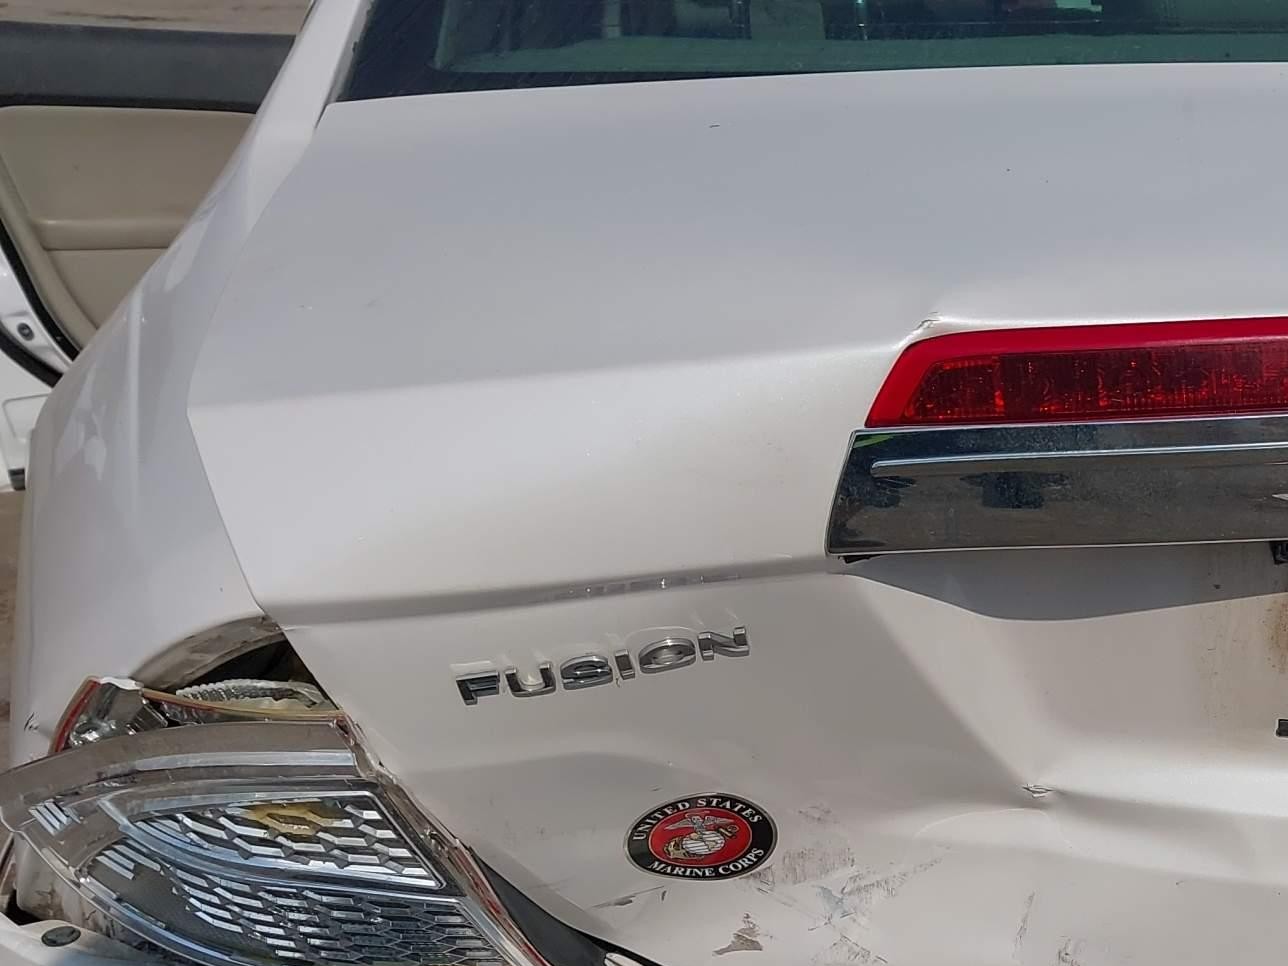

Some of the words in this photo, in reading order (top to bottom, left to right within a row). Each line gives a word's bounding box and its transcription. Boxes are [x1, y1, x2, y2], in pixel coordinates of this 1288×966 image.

[455, 626, 750, 706] FUSION
[632, 800, 691, 841] UNITED
[696, 797, 763, 824] STATES
[648, 860, 716, 877] MARINE
[718, 847, 765, 875] CORPS
